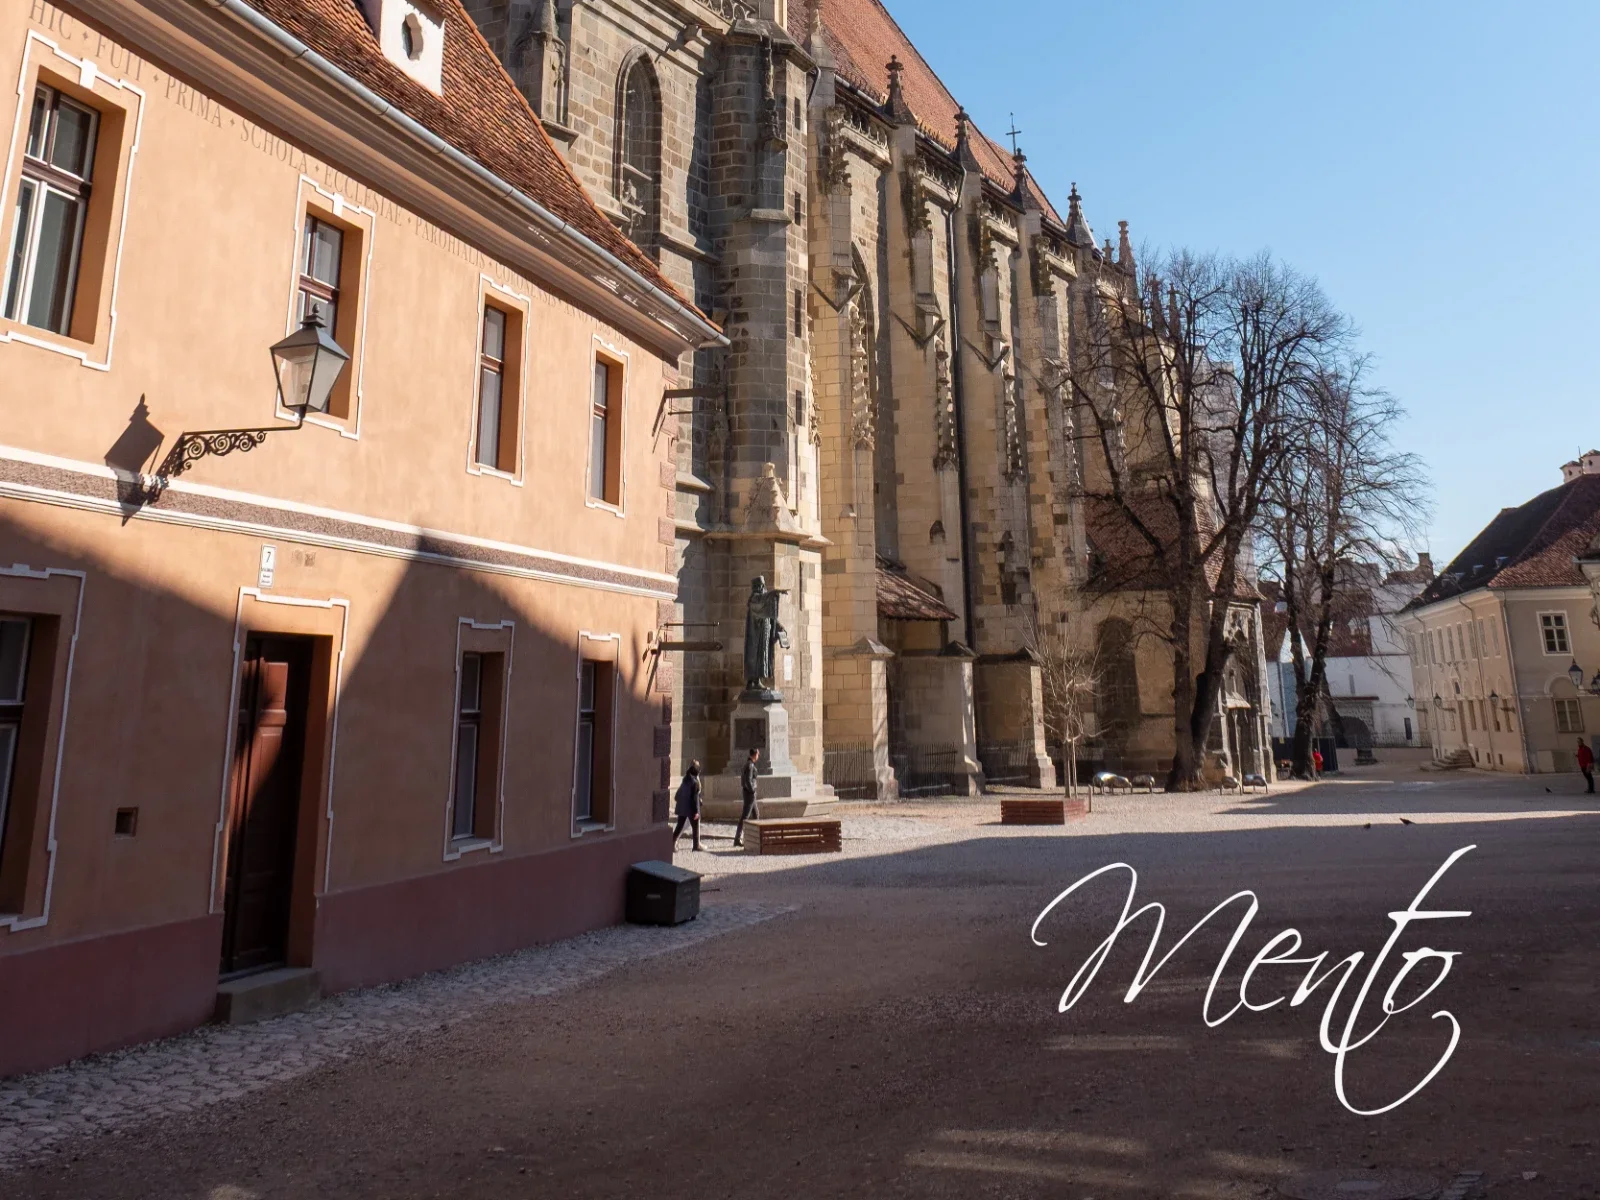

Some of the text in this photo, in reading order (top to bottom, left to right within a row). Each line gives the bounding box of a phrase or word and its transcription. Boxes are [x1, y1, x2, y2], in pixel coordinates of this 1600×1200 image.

[164, 75, 222, 129] PRIMA
[240, 118, 309, 174] SCHOLA
[324, 166, 402, 226] ECCLESIAE
[415, 216, 486, 269] PAROHIALIS
[266, 551, 271, 563] 7
